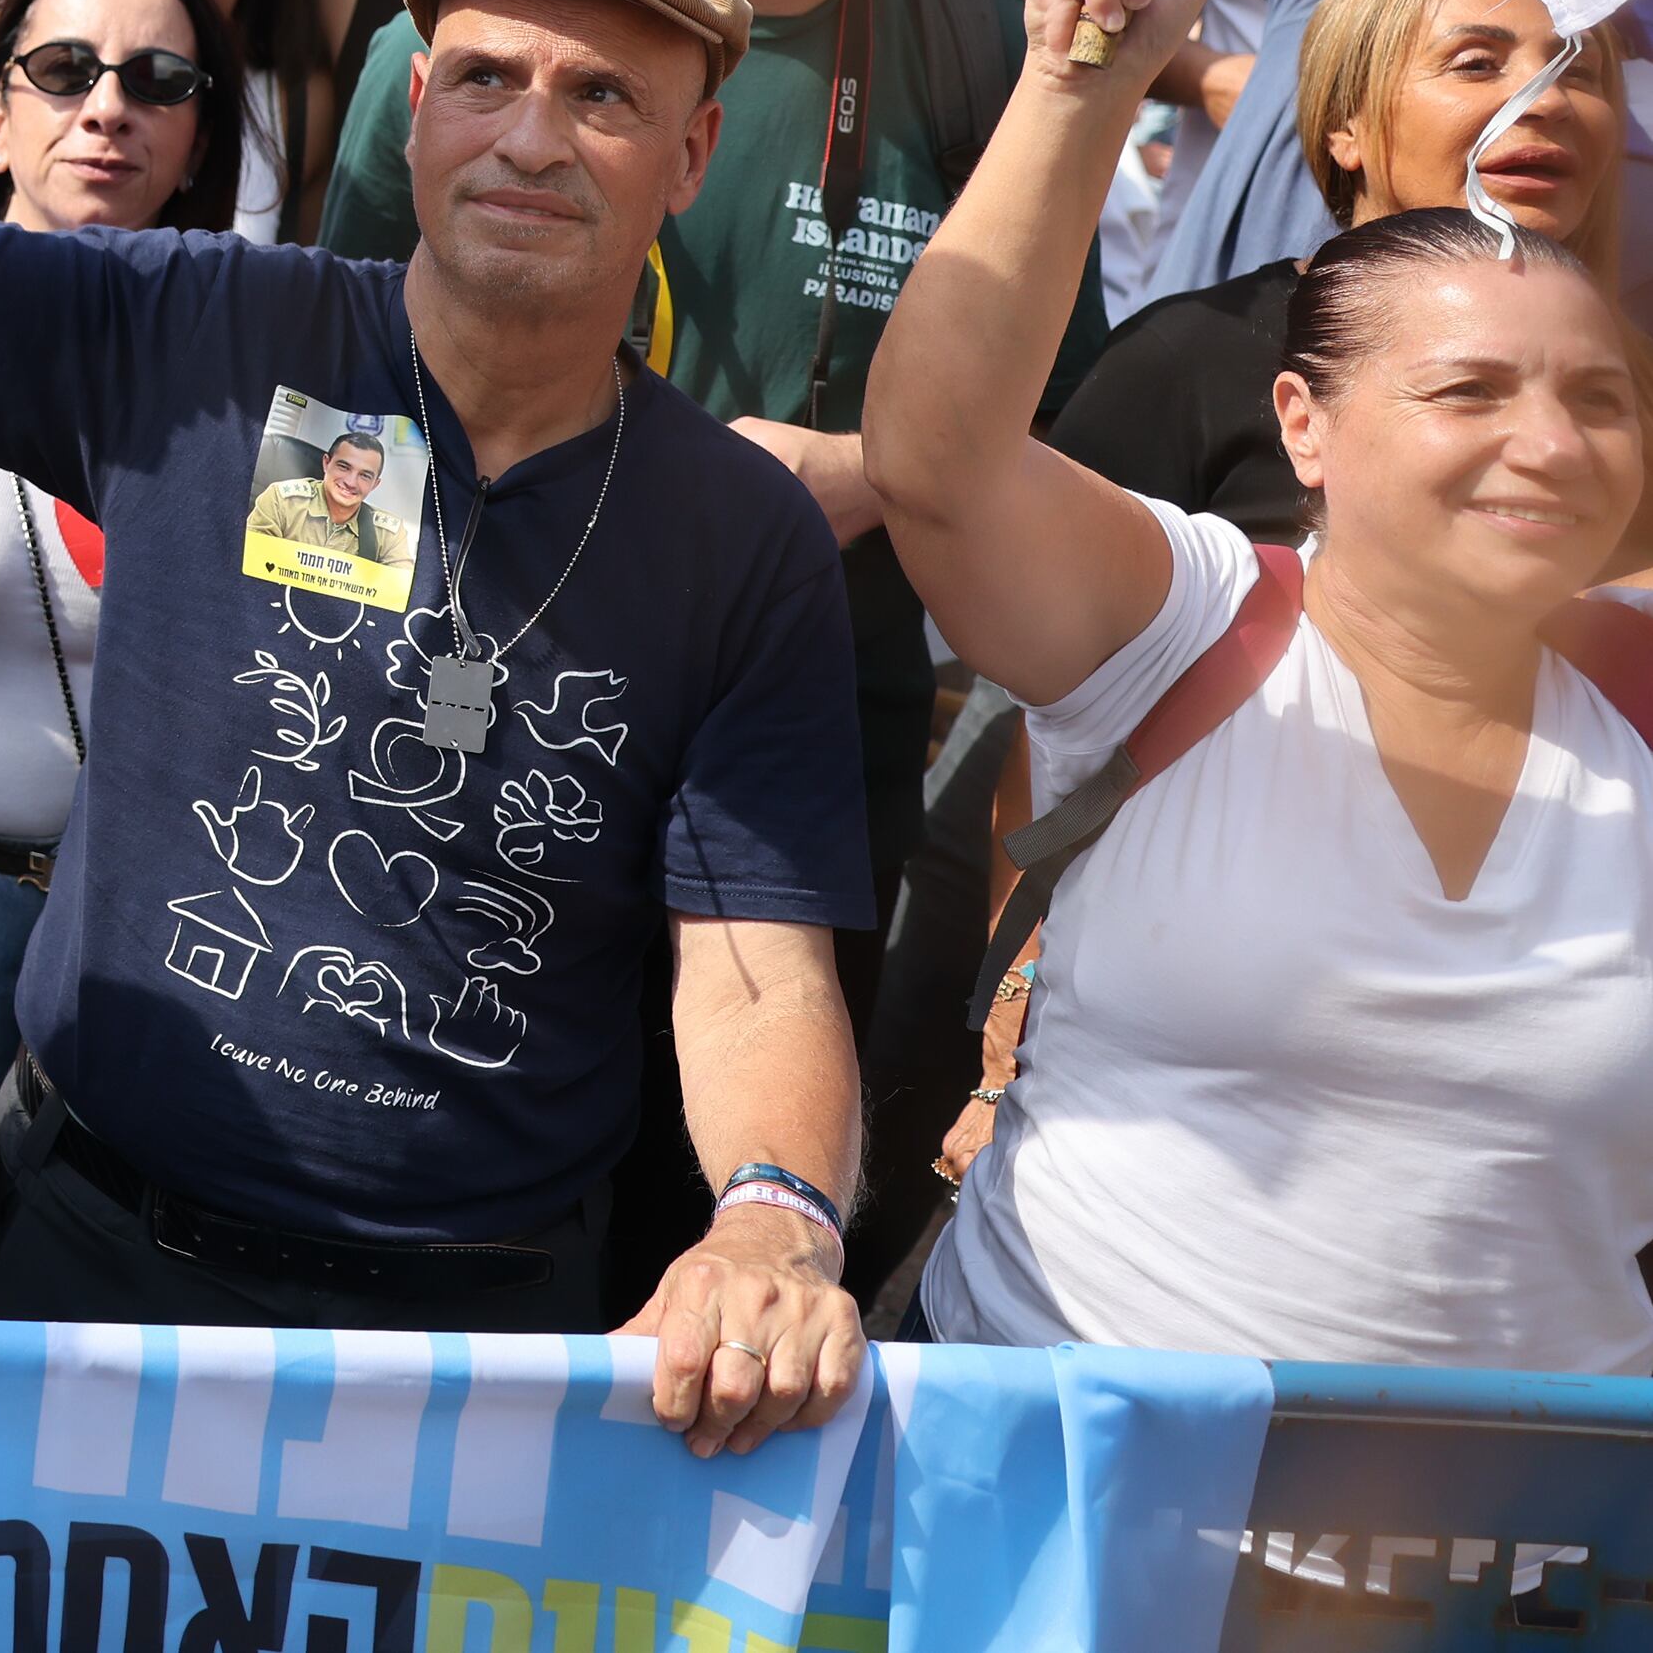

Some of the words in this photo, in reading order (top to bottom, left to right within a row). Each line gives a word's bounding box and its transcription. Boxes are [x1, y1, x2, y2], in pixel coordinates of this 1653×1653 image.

[838, 77, 858, 134] EOS
[818, 262, 888, 288] ILLUSION
[888, 277, 900, 291] &
[803, 278, 899, 313] PARADIS
[297, 551, 324, 569] חממי
[327, 558, 353, 576] אסף
[277, 566, 300, 580] מאחור
[300, 572, 316, 584] אחד
[316, 576, 328, 588] אף
[329, 576, 364, 594] משאירים
[365, 585, 377, 598] לא
[211, 1034, 272, 1073] Leave
[275, 1060, 308, 1083] No
[314, 1071, 359, 1100] One
[364, 1082, 440, 1111] Behind
